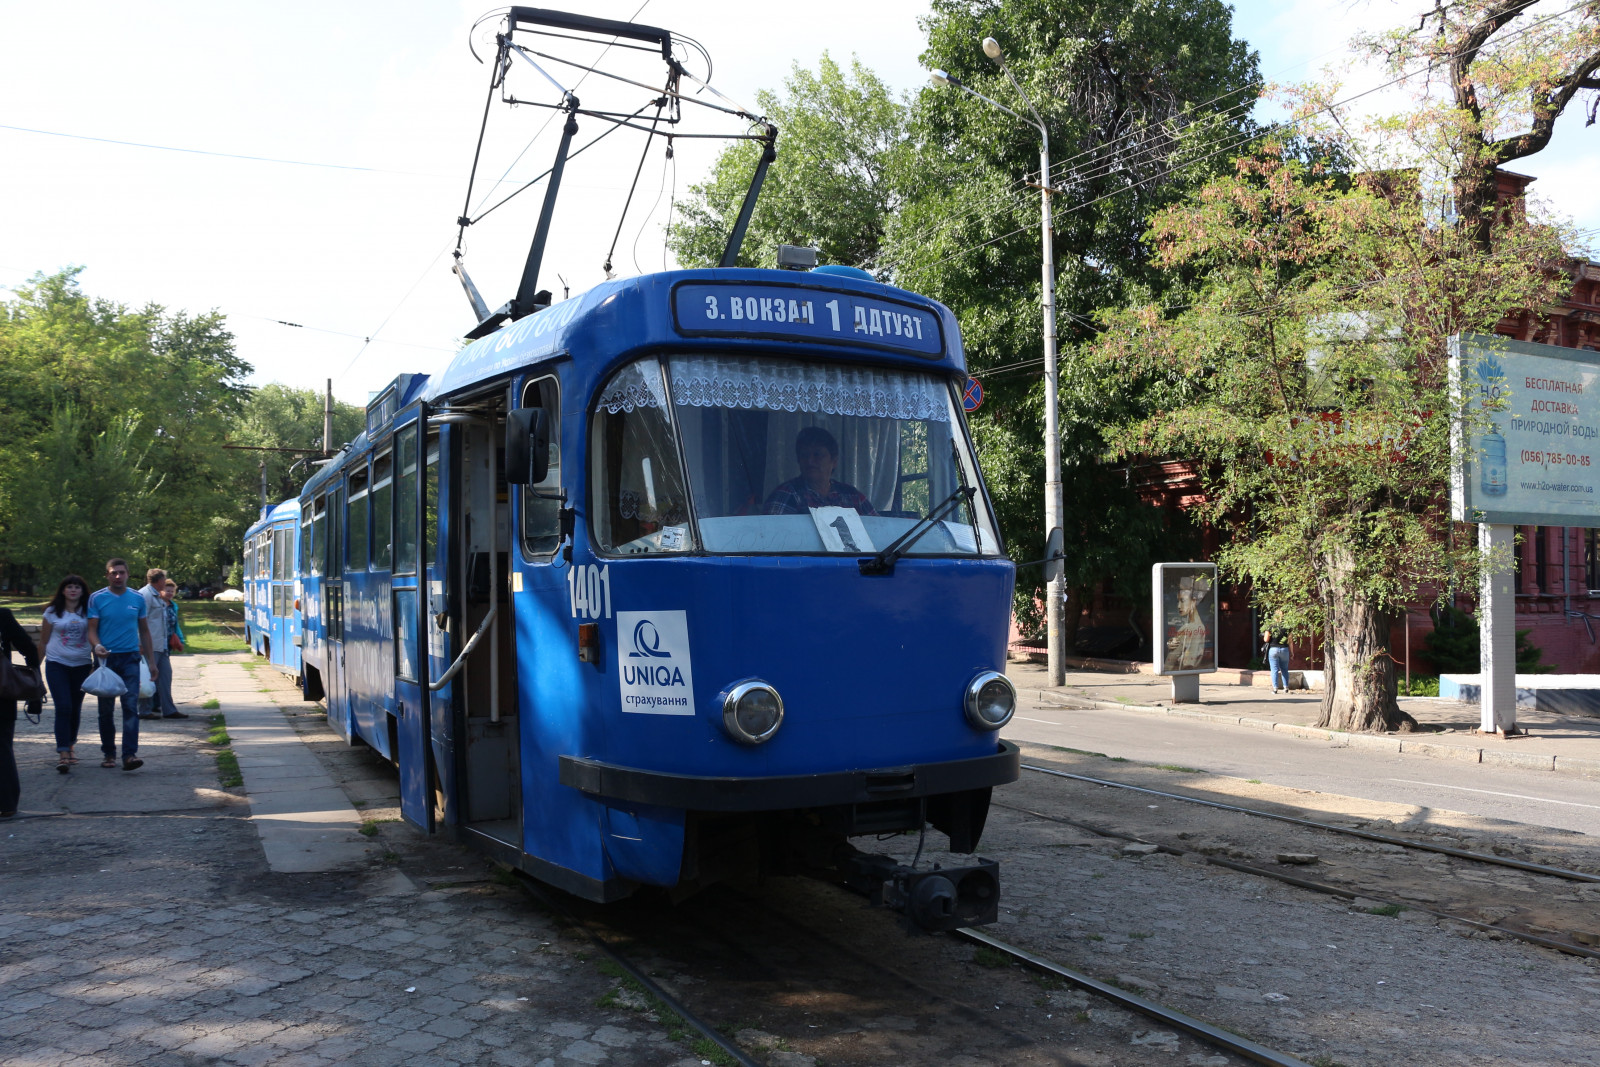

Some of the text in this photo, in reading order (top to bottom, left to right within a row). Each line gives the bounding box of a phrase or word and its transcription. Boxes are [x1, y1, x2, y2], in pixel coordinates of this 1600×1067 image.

[825, 299, 841, 332] 1
[854, 305, 923, 340] ДДТУЗТ
[1525, 376, 1583, 395] БЕСПЛАТНАЯ
[1531, 399, 1579, 415] ДОСТАВКА
[1511, 418, 1599, 440] ПРИРОДНОЙ ВОДЫ
[1520, 449, 1591, 467] (056) 785-00-85
[1520, 481, 1594, 494] www.h2o-water.com.ua
[829, 516, 861, 552] 1
[567, 563, 612, 620] 1401
[623, 665, 686, 687] UNIQA
[625, 695, 688, 708] страхування
